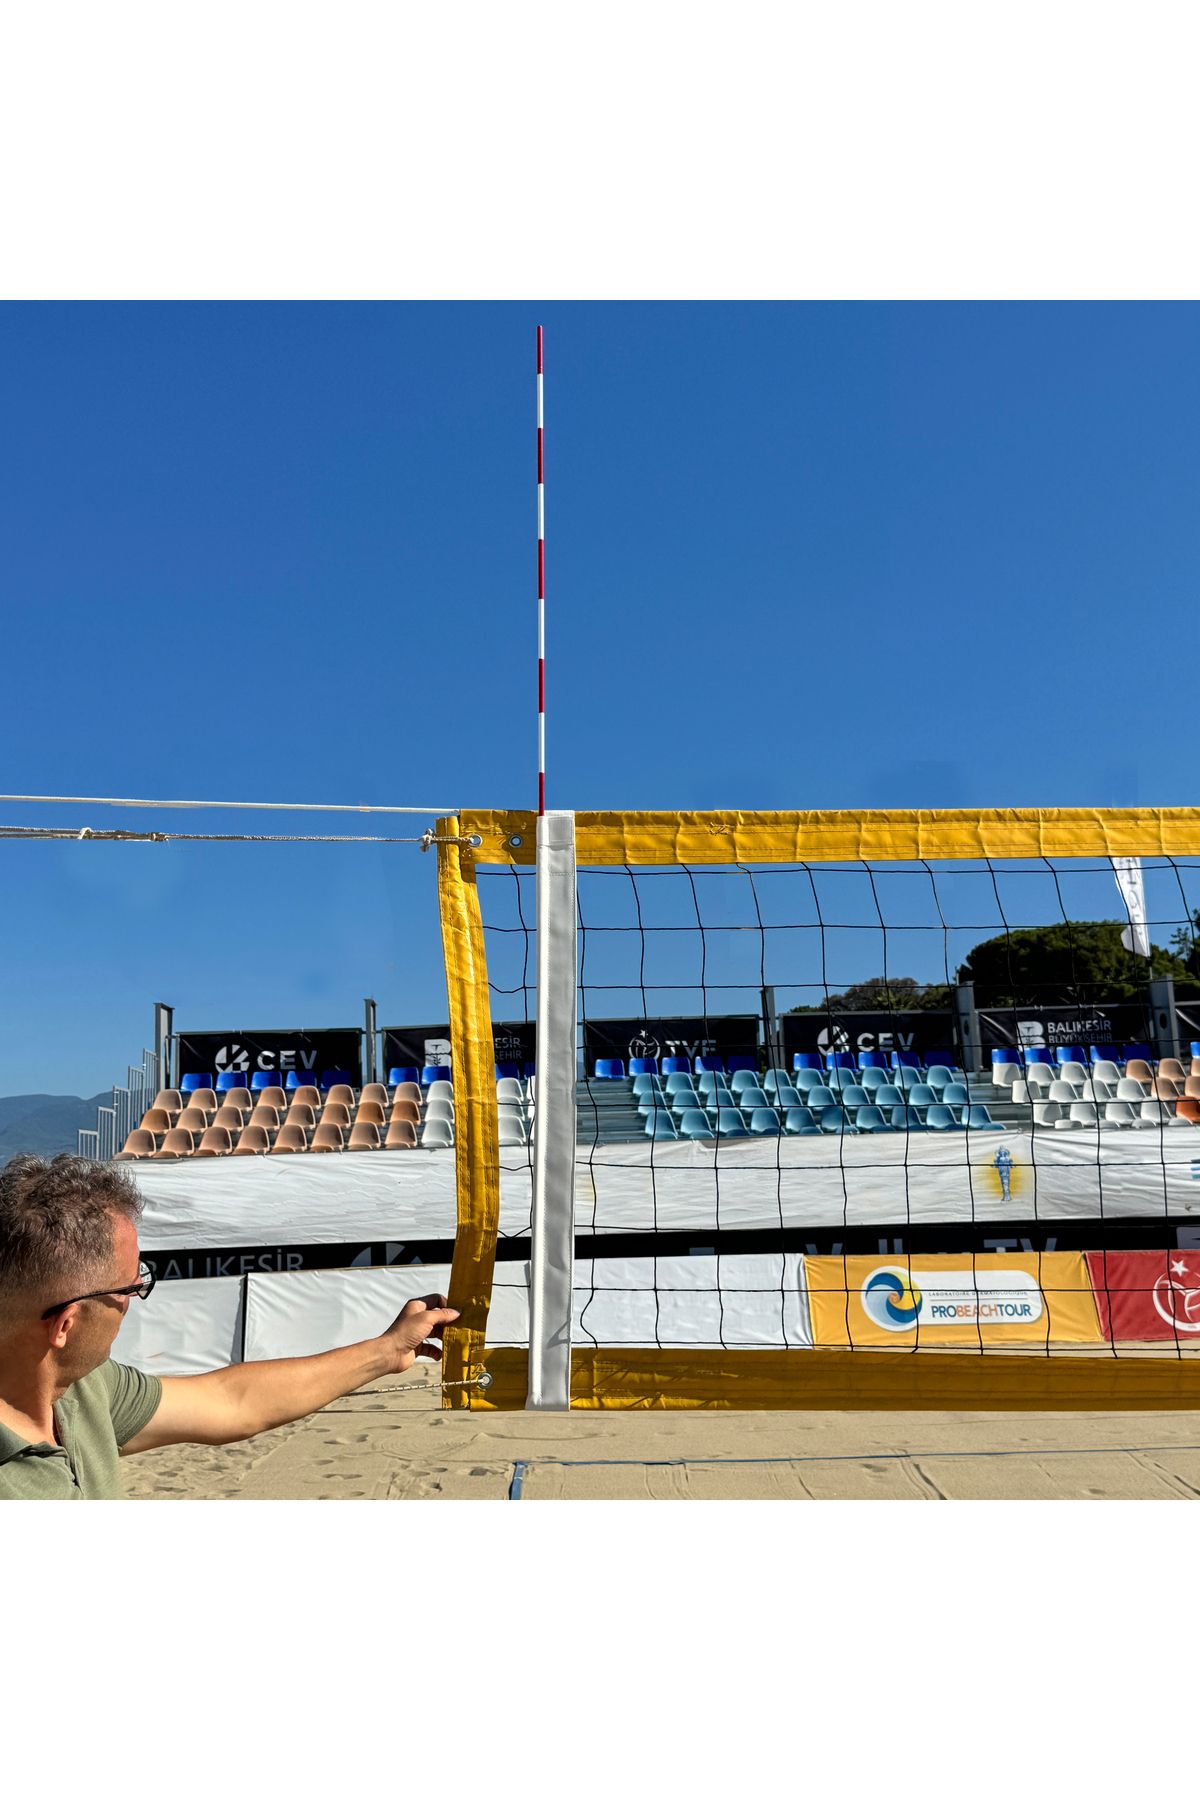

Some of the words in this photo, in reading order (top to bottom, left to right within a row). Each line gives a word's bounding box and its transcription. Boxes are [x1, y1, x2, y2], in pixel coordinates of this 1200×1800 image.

[665, 1039, 717, 1058] TVF
[857, 1032, 915, 1052] CEV
[257, 1050, 317, 1071] CEV
[930, 1303, 1033, 1319] PROBEACHTOUR
